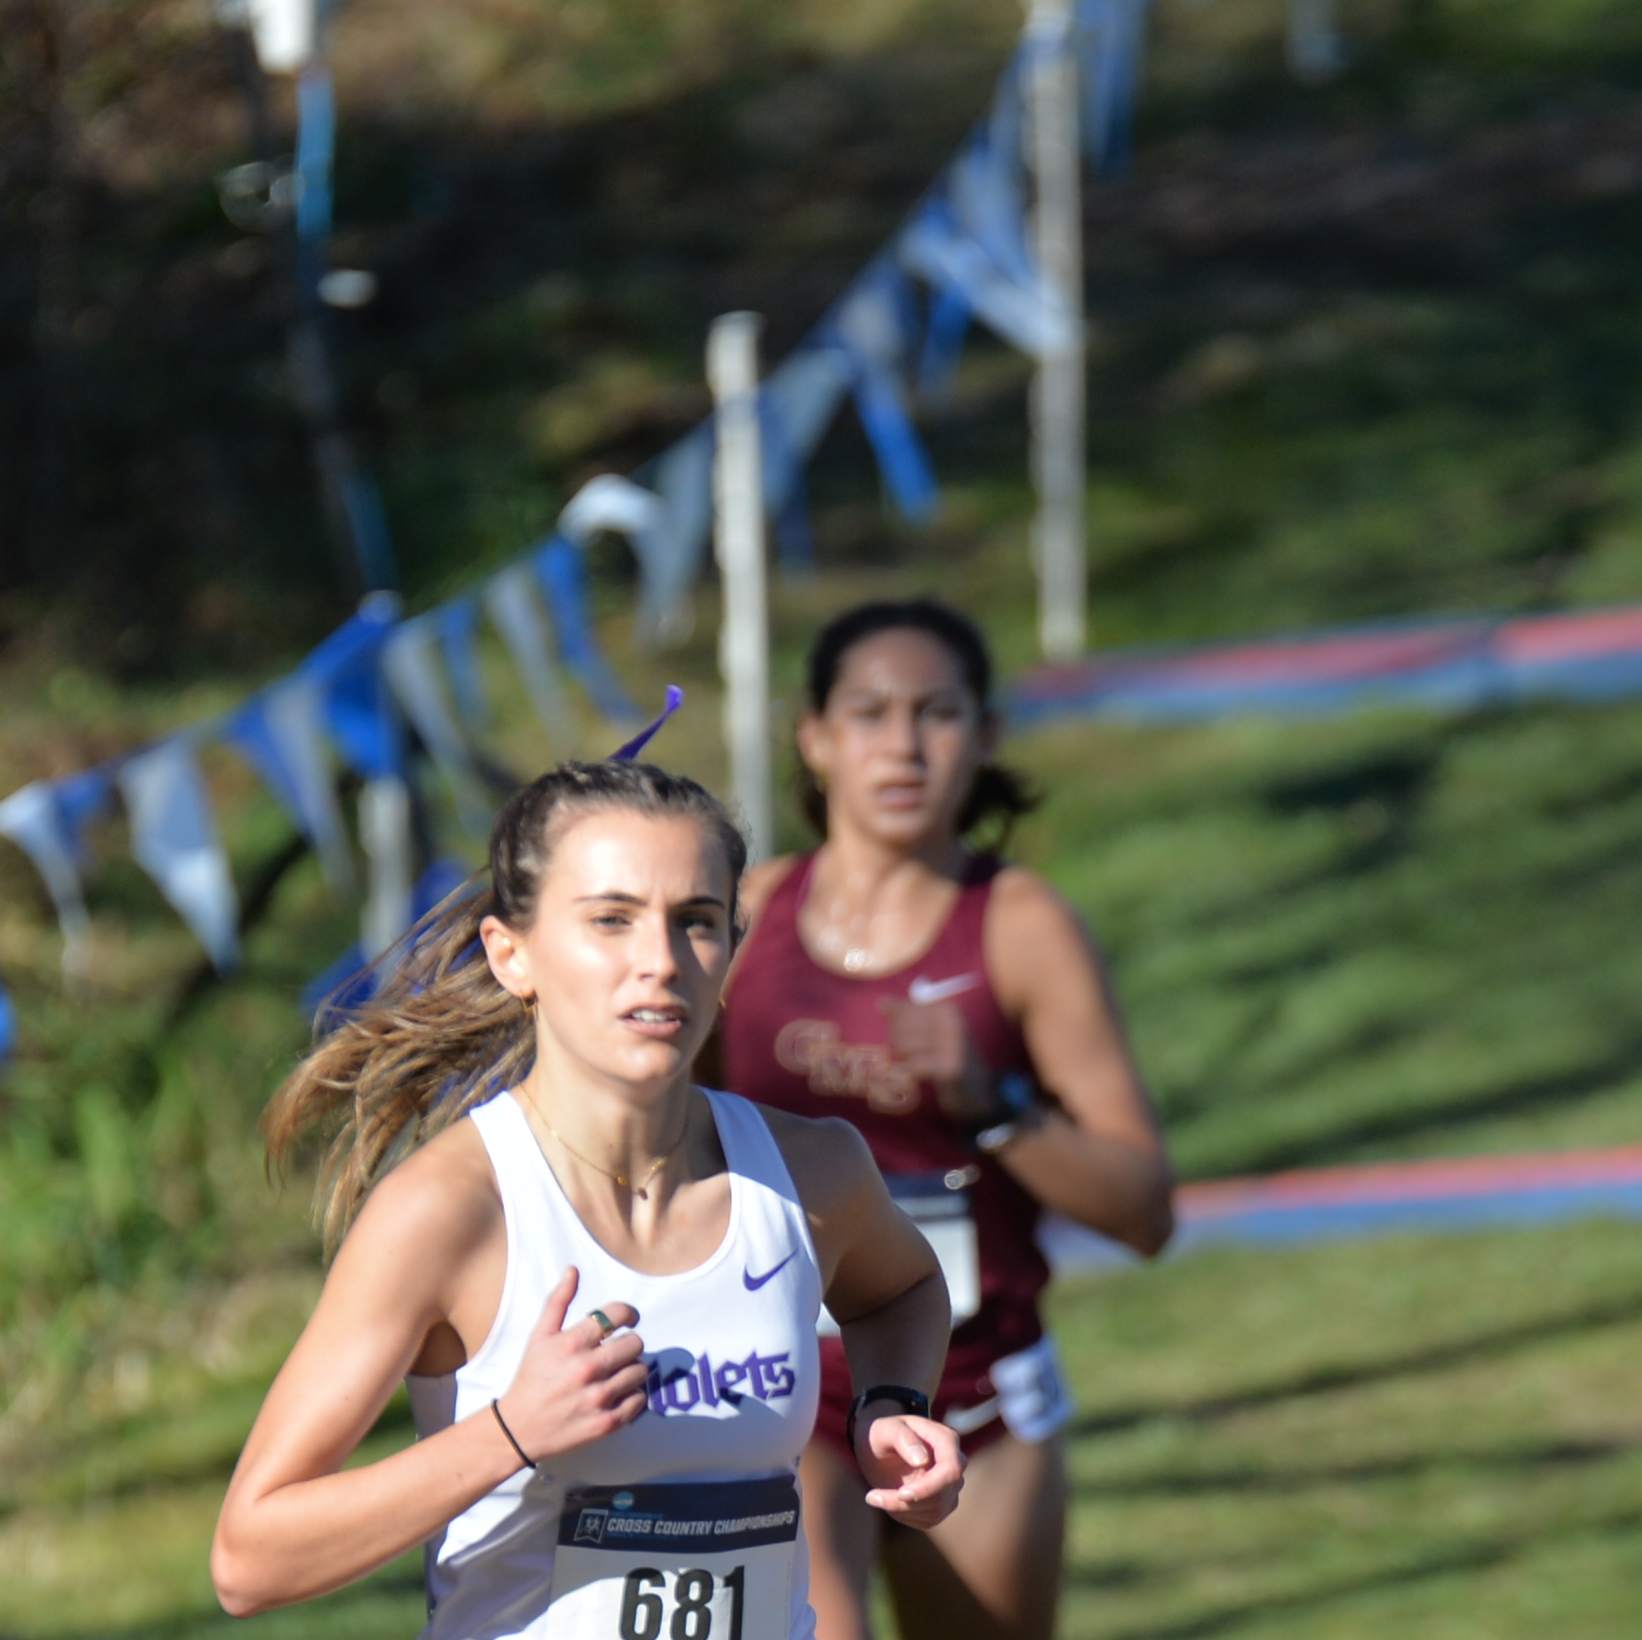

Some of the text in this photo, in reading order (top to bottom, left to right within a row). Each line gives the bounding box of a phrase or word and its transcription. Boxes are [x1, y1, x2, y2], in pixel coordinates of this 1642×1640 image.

[645, 1347, 796, 1416] iolets
[607, 1517, 652, 1534] CROSS
[654, 1519, 712, 1536] COUNTRY
[713, 1510, 796, 1536] CHAMPIONSHIPS
